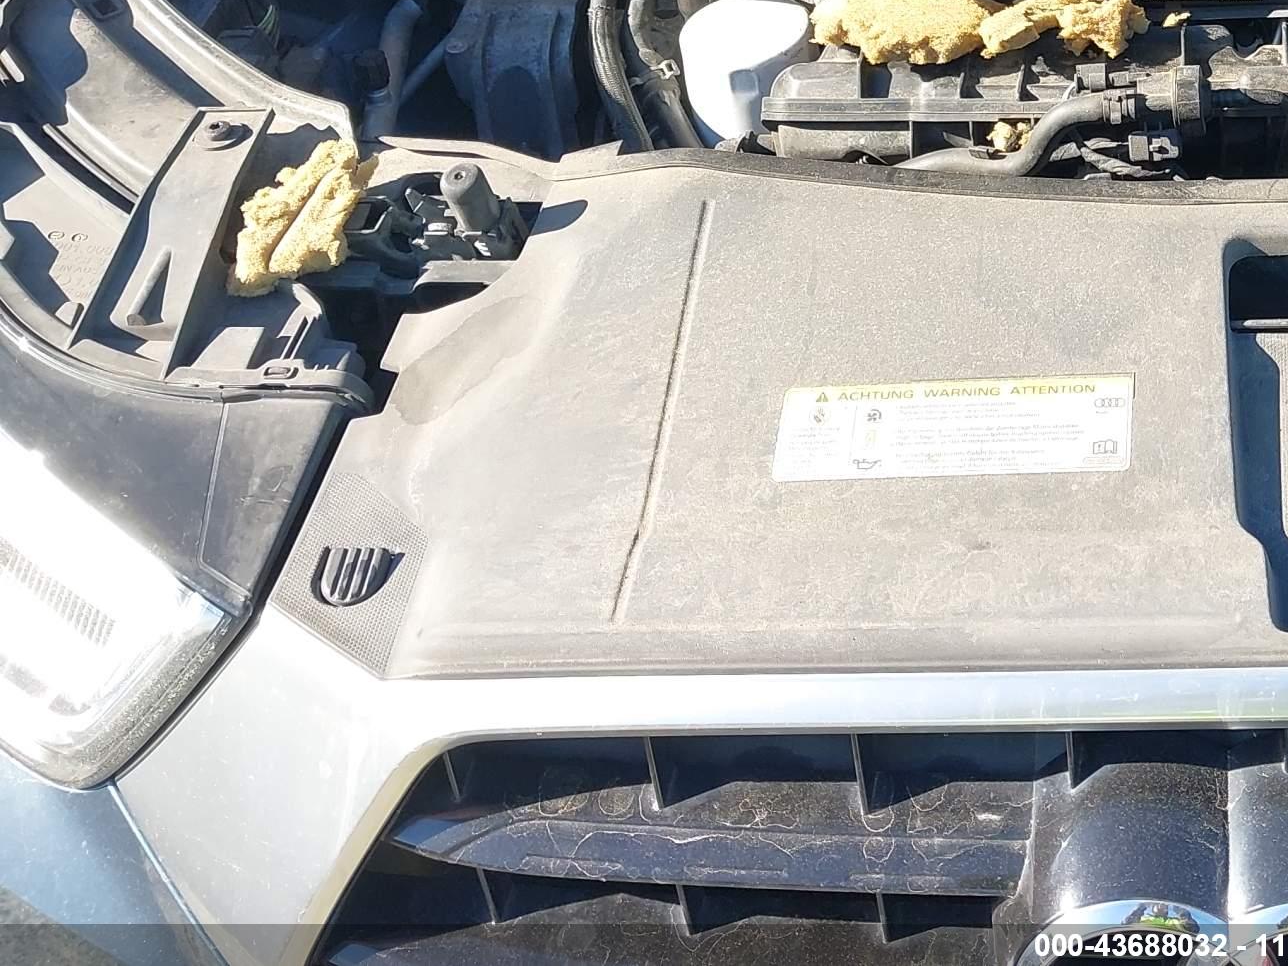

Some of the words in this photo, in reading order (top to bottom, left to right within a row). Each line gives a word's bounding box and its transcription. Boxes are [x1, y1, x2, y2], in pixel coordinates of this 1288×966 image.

[837, 390, 915, 402] ACHTUNG
[923, 386, 1001, 399] WARNING
[1010, 383, 1096, 395] ATTENTION
